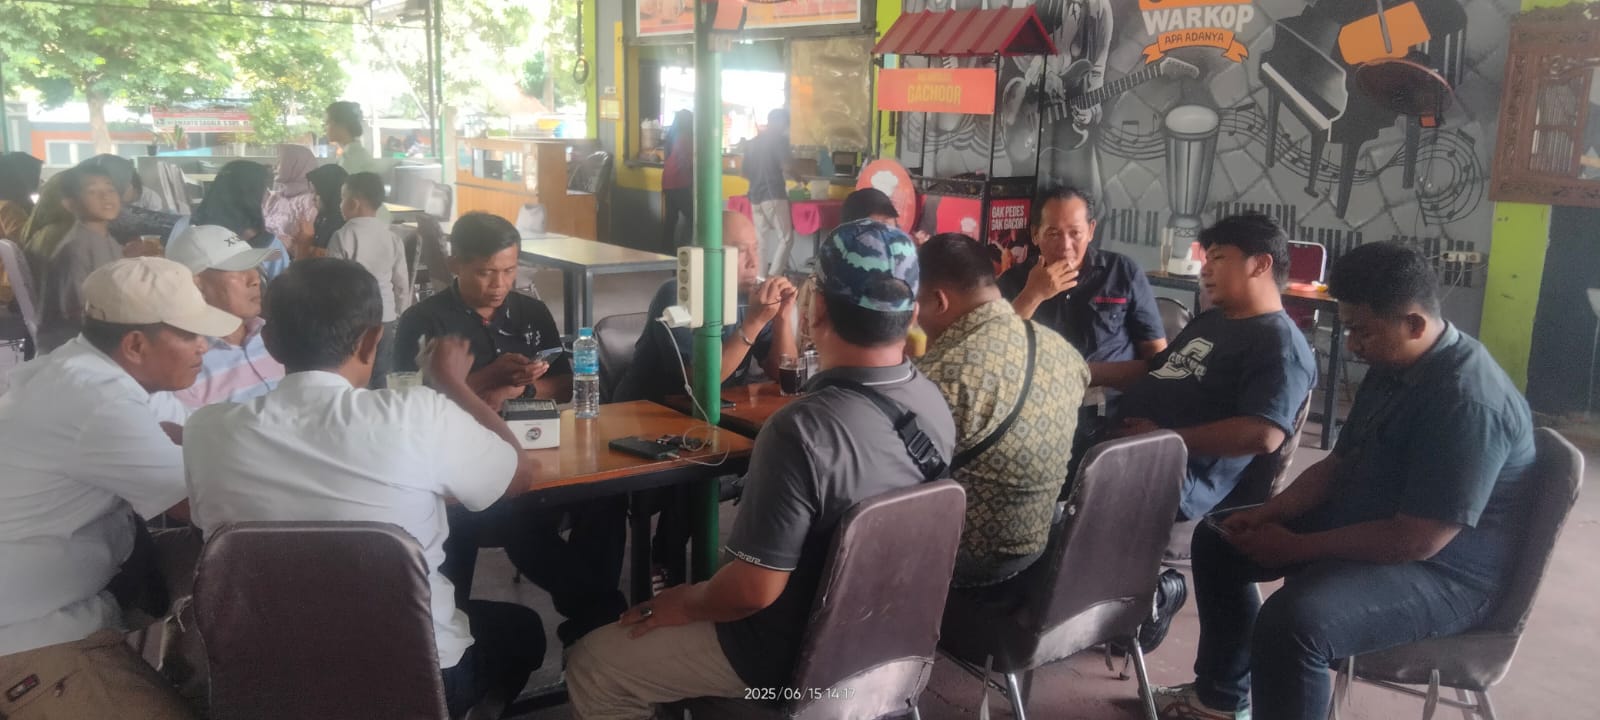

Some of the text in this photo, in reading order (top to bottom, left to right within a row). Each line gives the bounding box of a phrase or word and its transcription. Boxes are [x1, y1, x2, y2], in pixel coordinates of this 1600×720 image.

[1142, 4, 1254, 36] WARKOP
[1165, 31, 1224, 44] APA ADANYA
[992, 205, 1004, 218] GAK
